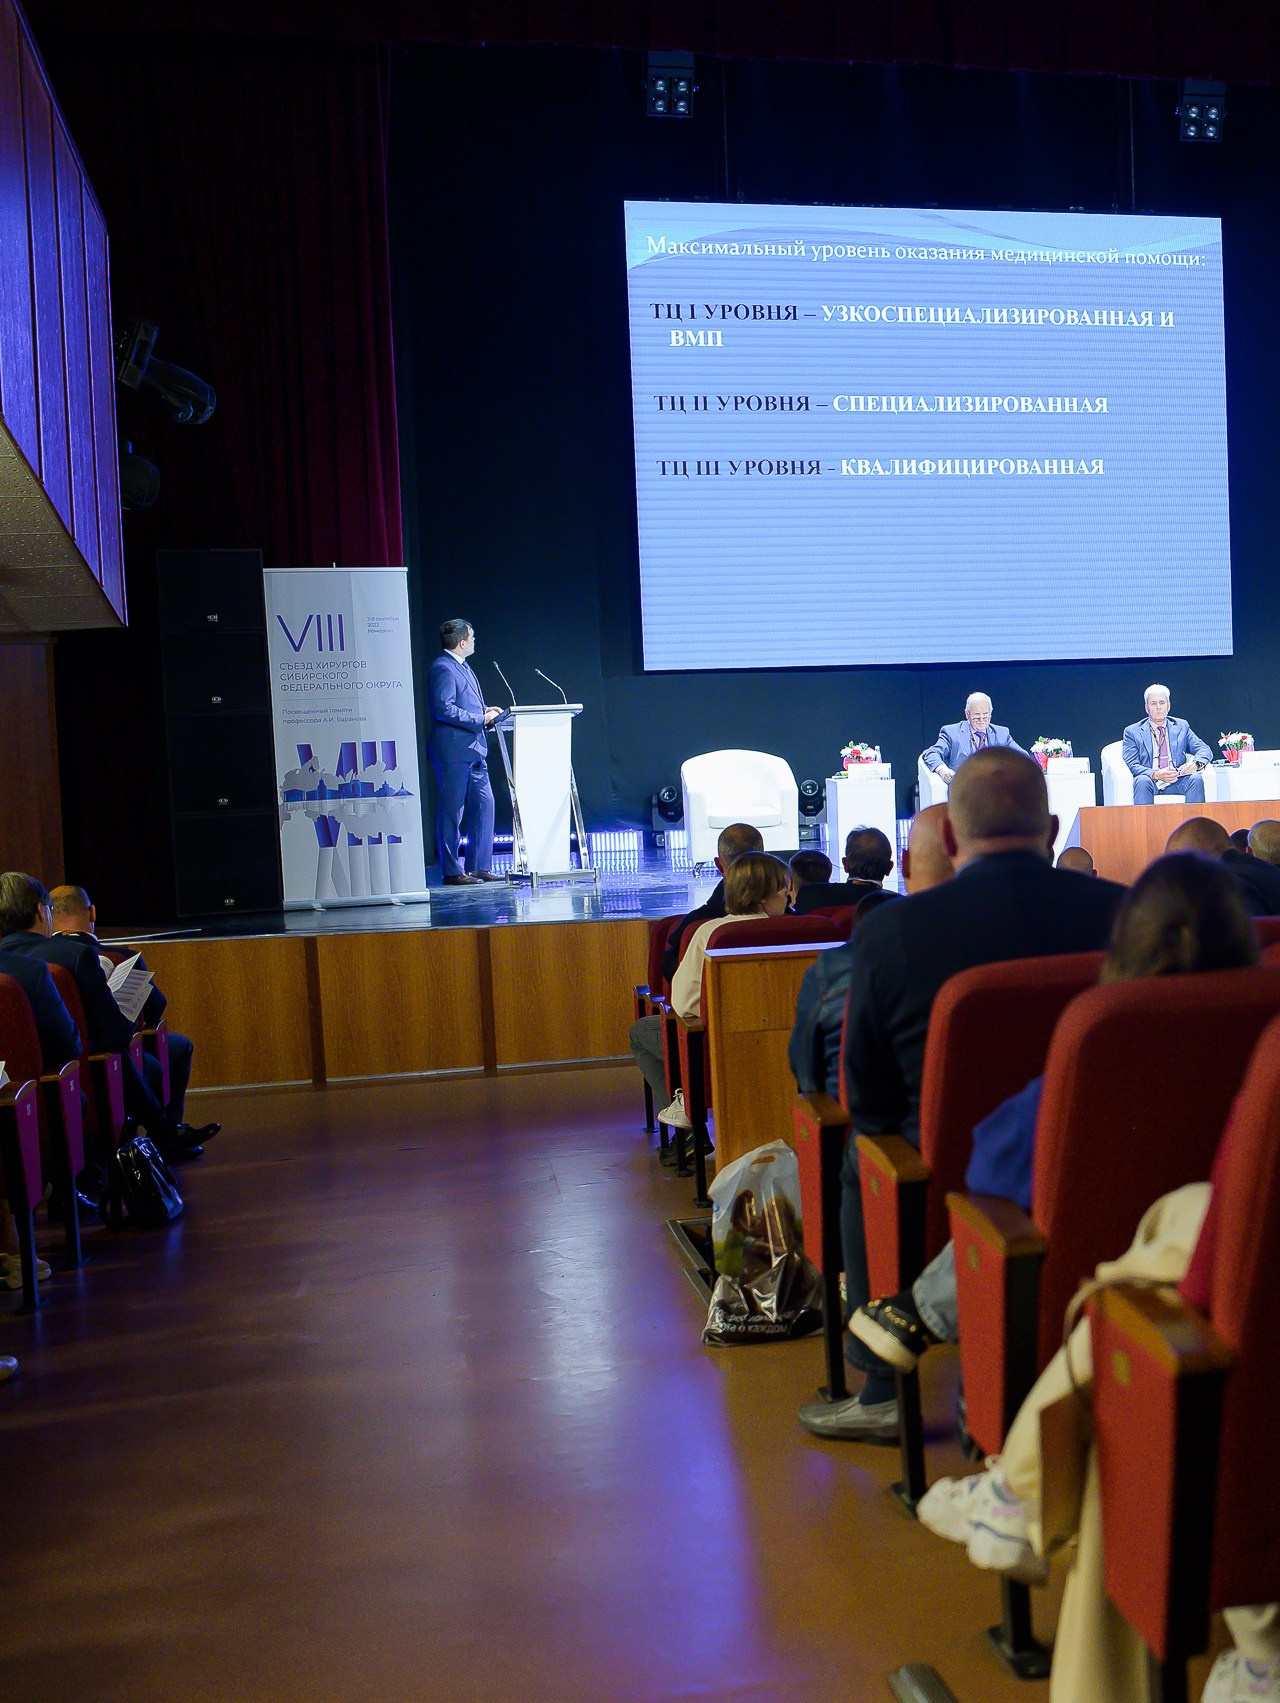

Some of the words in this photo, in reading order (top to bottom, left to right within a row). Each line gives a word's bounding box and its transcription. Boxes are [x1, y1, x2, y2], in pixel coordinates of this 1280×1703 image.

[646, 235, 806, 257] Максимальный
[812, 243, 891, 262] уровень
[895, 245, 985, 261] оказания
[990, 248, 1119, 266] медицинской
[1125, 252, 1206, 269] помощи:
[650, 303, 683, 323] ТЦ
[703, 303, 799, 321] УРОВНЯ
[821, 304, 1155, 328] УЗКОСПЕЦИАЛИЗИРОВАННАЯ
[1159, 310, 1176, 328] И
[669, 329, 725, 347] ВМП
[654, 395, 688, 415] ТЦ
[716, 394, 811, 412] УРОВНЯ
[832, 394, 1110, 415] СПЕЦИАЛИЗИРОВАННАЯ
[656, 459, 690, 480] ТЦ
[728, 459, 822, 476] УРОВНЯ
[840, 458, 1106, 479] КВАЛИФИЦИРОВАННАЯ
[276, 613, 345, 652] VIII
[279, 661, 313, 671] СЪЕЗД
[315, 660, 367, 670] ХИРУРГОВ
[280, 671, 349, 682] СИБИРСКОГО
[280, 681, 364, 692] ФЕДЕРАЛЬНОГО
[366, 680, 403, 689] ОКРУГА
[282, 717, 322, 725] профессора
